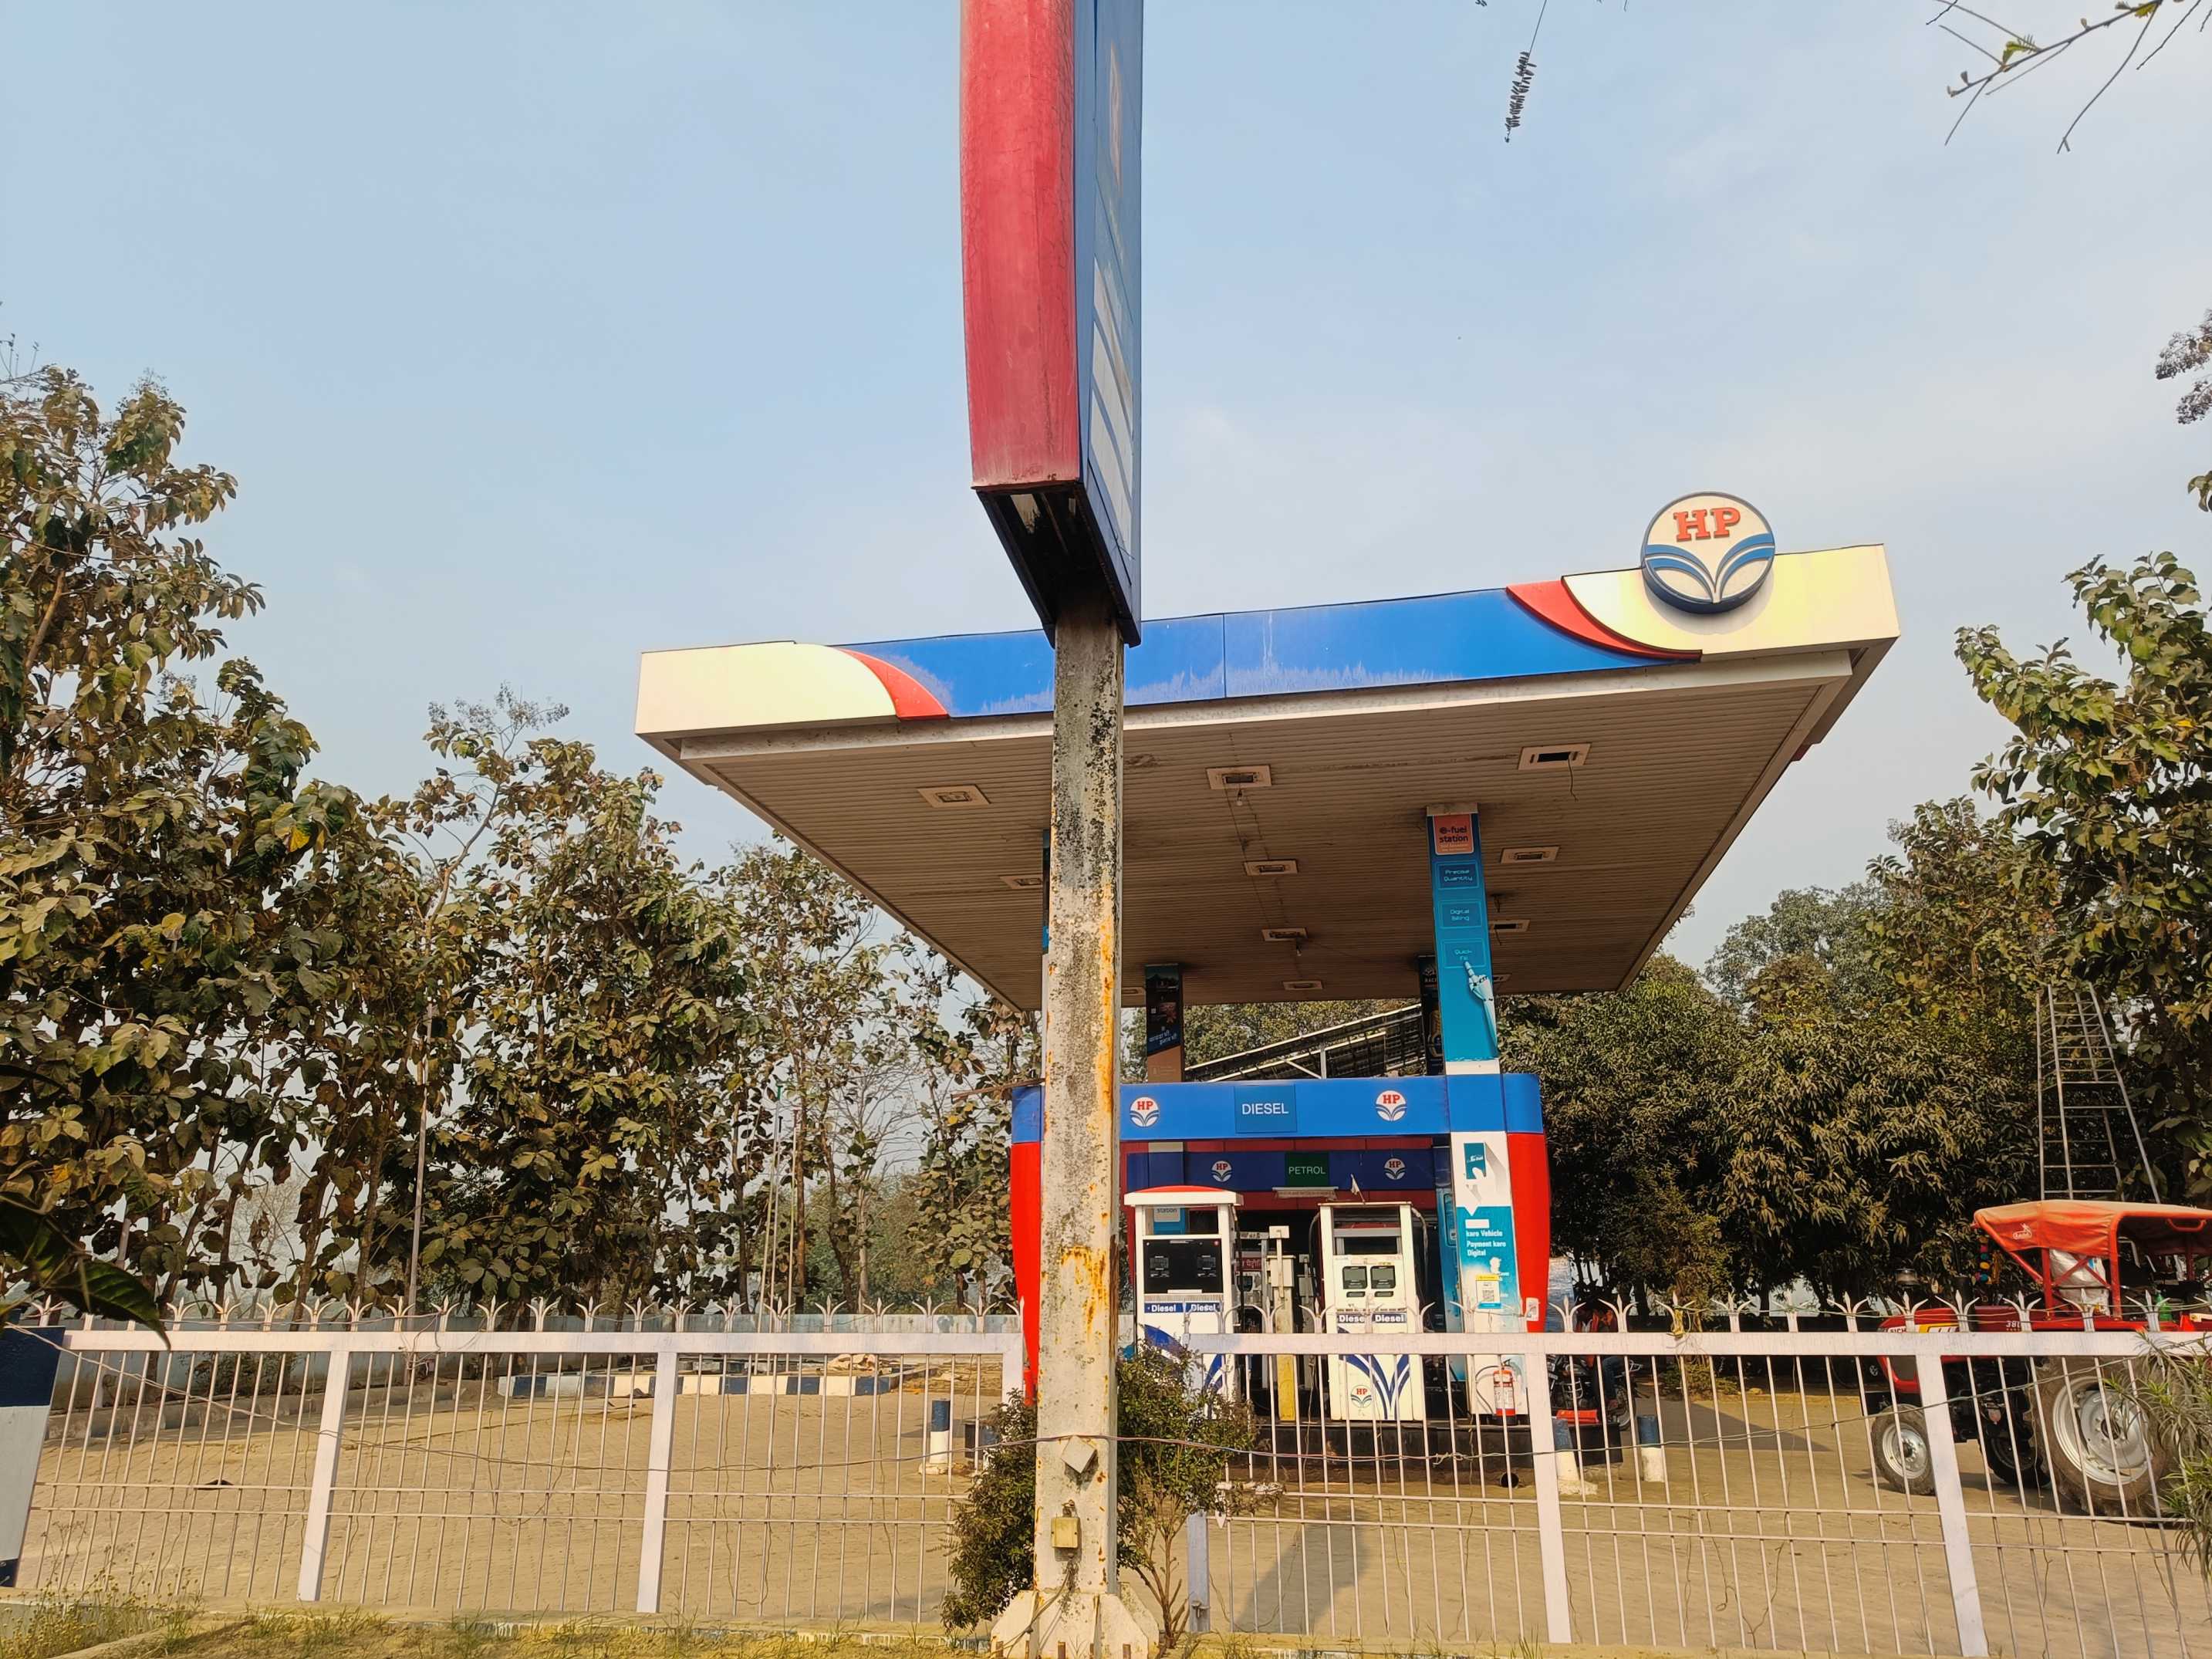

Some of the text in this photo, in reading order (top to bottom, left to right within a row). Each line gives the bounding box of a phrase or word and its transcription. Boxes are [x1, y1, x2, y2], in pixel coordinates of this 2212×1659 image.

[1673, 507, 1741, 542] HP
[1439, 834, 1468, 843] station
[1382, 1094, 1400, 1104] HP
[1137, 1100, 1153, 1110] HP
[1241, 1103, 1289, 1115] DIESEL
[1288, 1166, 1326, 1174] PETROL
[1467, 1240, 1492, 1249] Payment
[1467, 1249, 1486, 1258] Digital
[1151, 1304, 1177, 1313] Diesel
[1190, 1303, 1217, 1312] Diesel
[1375, 1313, 1404, 1323] Diesel
